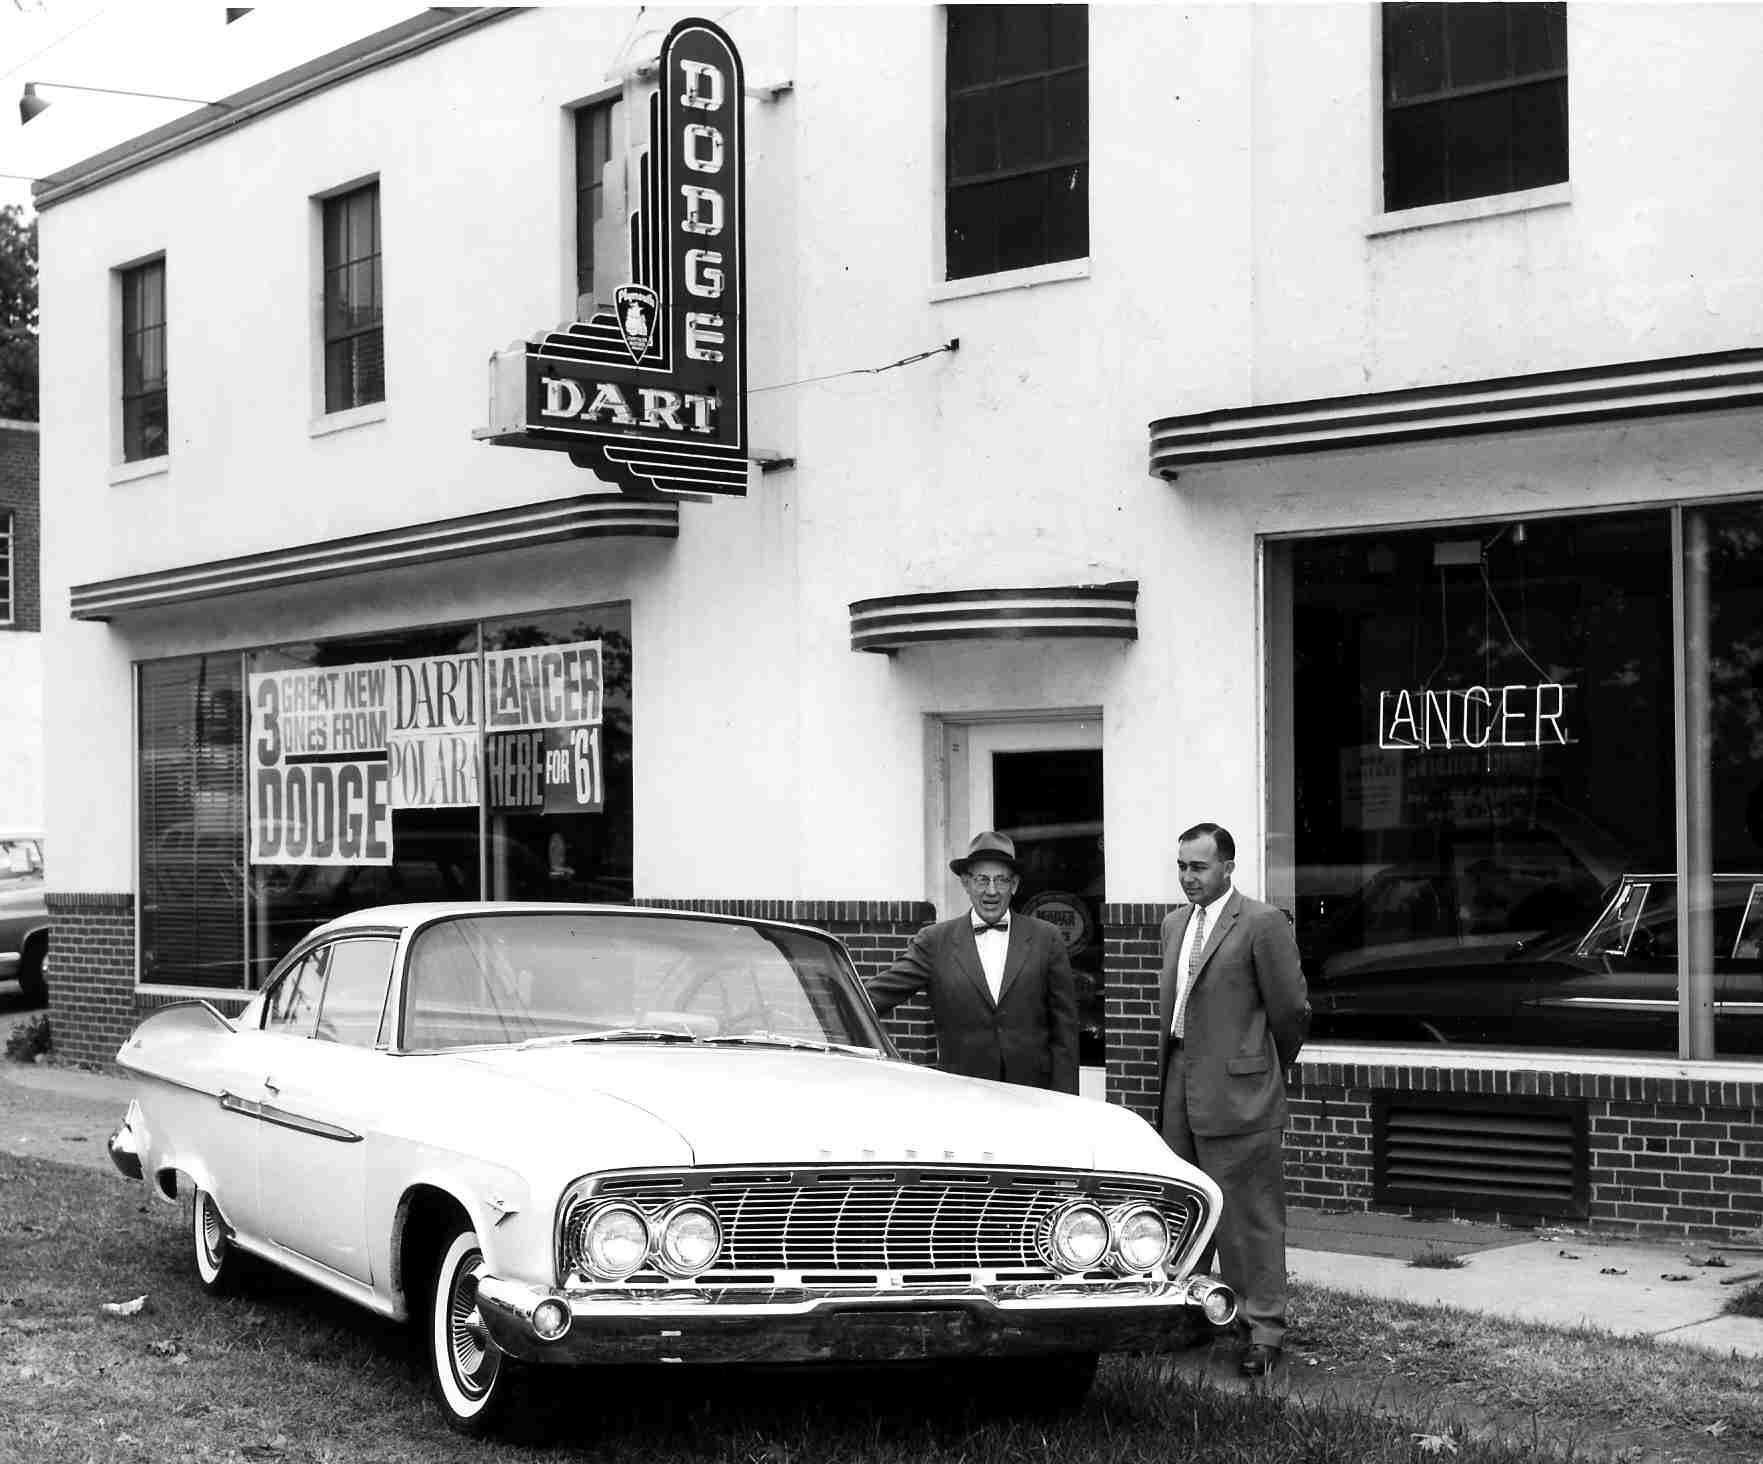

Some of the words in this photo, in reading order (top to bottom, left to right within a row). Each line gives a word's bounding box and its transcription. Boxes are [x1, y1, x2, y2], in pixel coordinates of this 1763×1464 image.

[680, 59, 725, 362] DODGE
[541, 376, 717, 434] DART
[257, 679, 281, 767] 3
[282, 673, 339, 712] GREAT
[344, 669, 386, 708] NEW
[392, 658, 479, 730] DART
[488, 649, 600, 725] LANCER
[1378, 683, 1567, 750] LANCER
[284, 715, 327, 752] ONES
[333, 711, 387, 750] FROM
[387, 737, 481, 804] POLARA
[489, 733, 544, 806] HERE
[546, 749, 570, 784] FOR
[258, 764, 387, 859] DODGE
